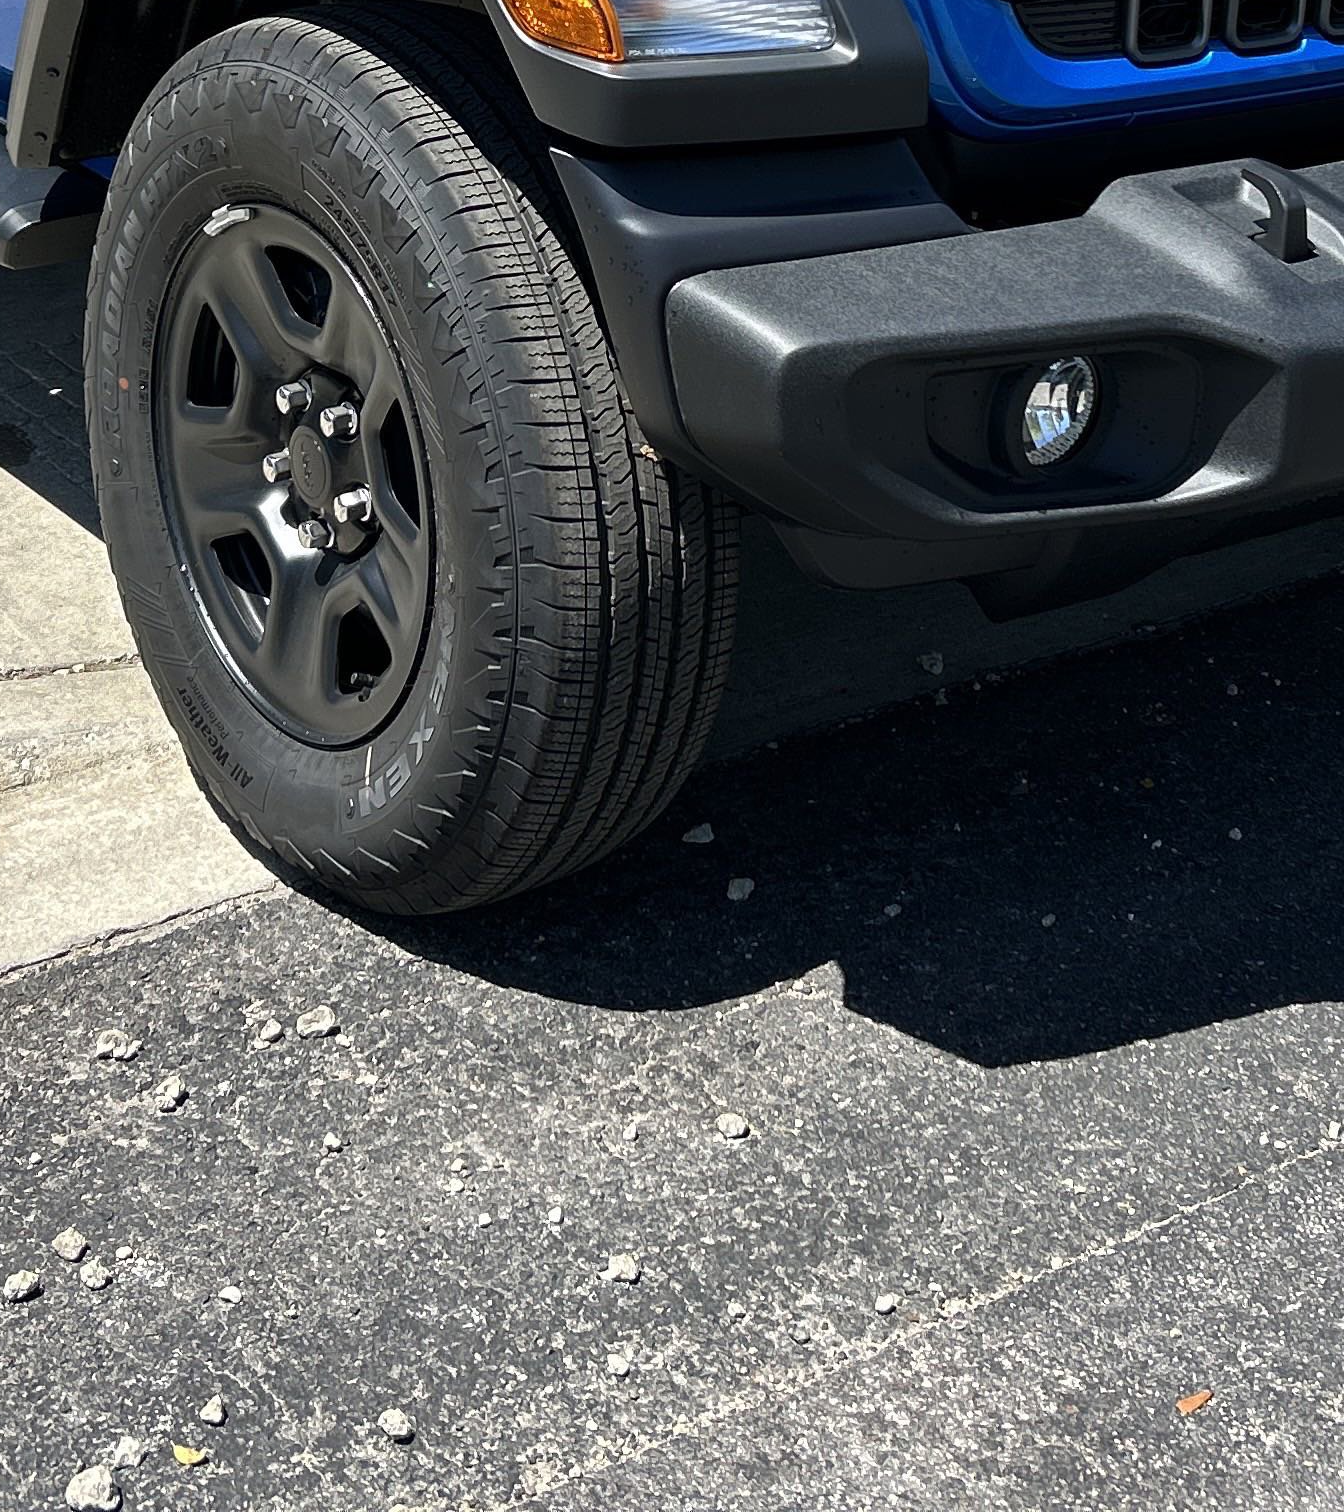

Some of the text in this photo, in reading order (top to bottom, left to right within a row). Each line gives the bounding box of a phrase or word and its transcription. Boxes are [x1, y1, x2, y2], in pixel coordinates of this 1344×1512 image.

[101, 206, 147, 453] ROADIAN
[176, 686, 255, 789] All-Weather
[186, 676, 230, 741] Performance
